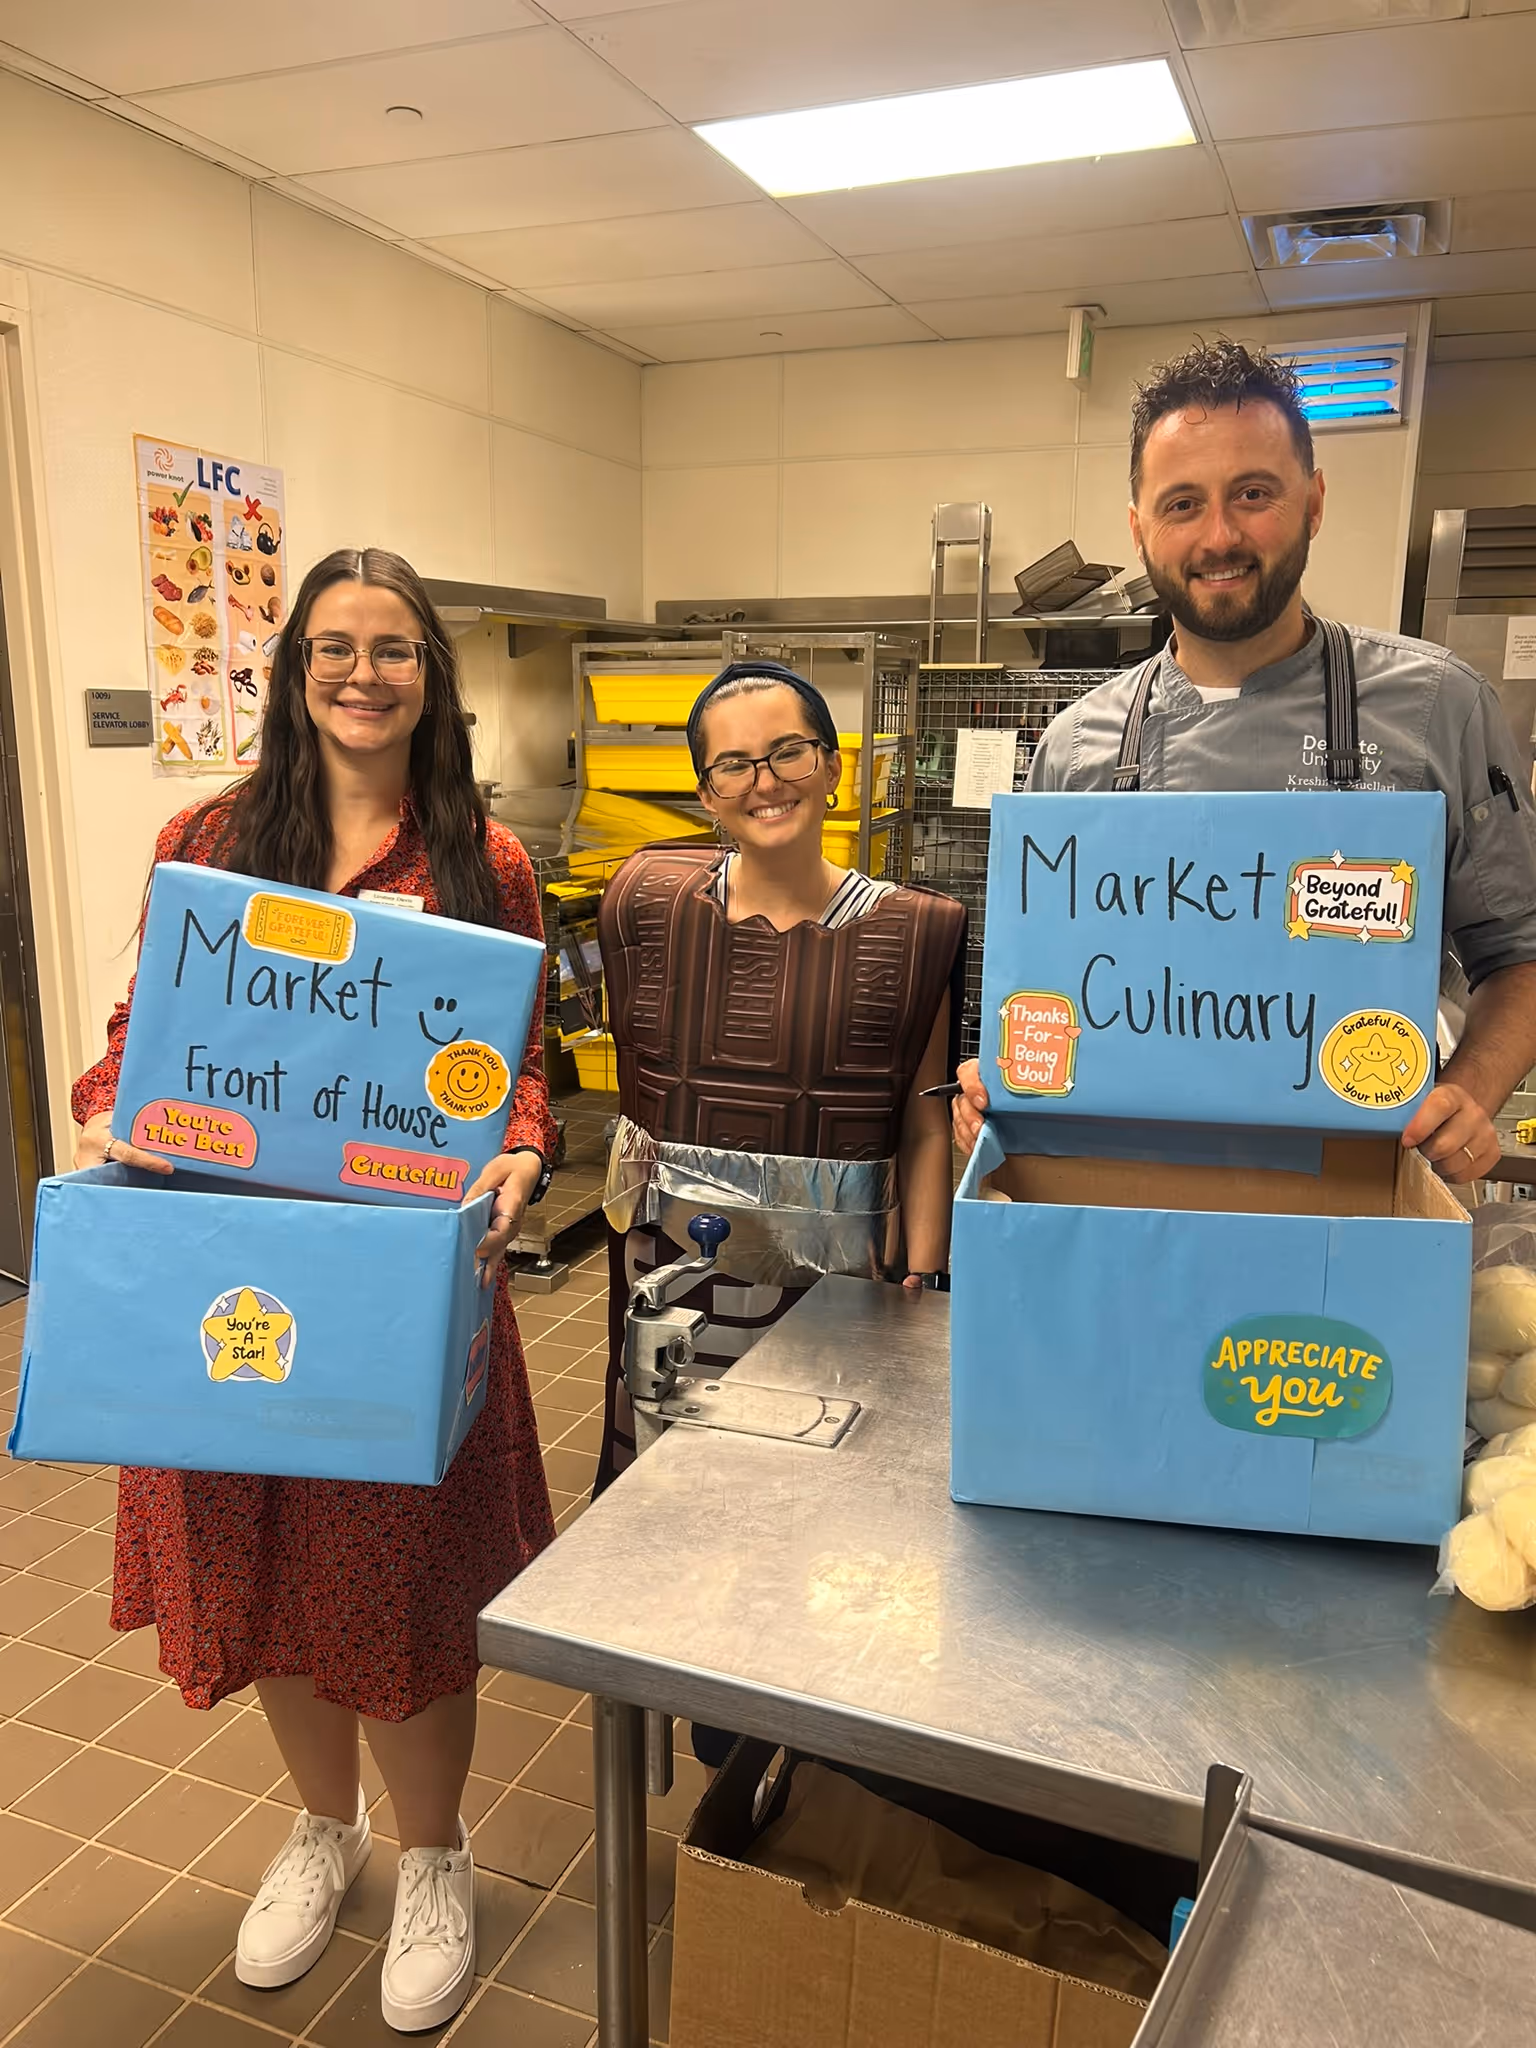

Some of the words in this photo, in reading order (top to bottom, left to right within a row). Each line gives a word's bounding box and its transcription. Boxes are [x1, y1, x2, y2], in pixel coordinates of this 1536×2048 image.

[147, 470, 167, 480] power
[168, 474, 184, 482] knot
[197, 457, 241, 496] LFC
[92, 711, 120, 720] SERVICE
[93, 720, 128, 729] ELEVATOR
[129, 720, 150, 729] LOBBY
[1020, 833, 1276, 922] Market
[1306, 874, 1382, 901] Beyond
[276, 911, 326, 930] FOREVER
[1305, 898, 1397, 924] Grateful!
[174, 908, 392, 1028] Market
[723, 925, 781, 1041] HERSH
[1011, 1004, 1069, 1025] Thanks
[1082, 954, 1316, 1090] Culinary
[1342, 1015, 1391, 1035] Grateful
[1392, 1021, 1410, 1038] For
[447, 1048, 482, 1061] THANK
[482, 1052, 499, 1071] YOU
[1015, 1044, 1058, 1068] Being
[1016, 1064, 1053, 1085] You!
[185, 1045, 288, 1112] Front
[313, 1075, 350, 1122] of
[362, 1081, 449, 1148] House
[440, 1090, 468, 1113] THANK
[469, 1100, 489, 1113] YOU
[1343, 1082, 1371, 1102] Your
[1375, 1086, 1406, 1103] Help!
[164, 1107, 234, 1135] You're
[145, 1124, 188, 1146] The
[194, 1133, 246, 1158] Best
[350, 1155, 459, 1190] Grateful
[227, 1316, 270, 1331] You're
[232, 1346, 265, 1360] Star!
[1210, 1336, 1384, 1380] APPRECIATE
